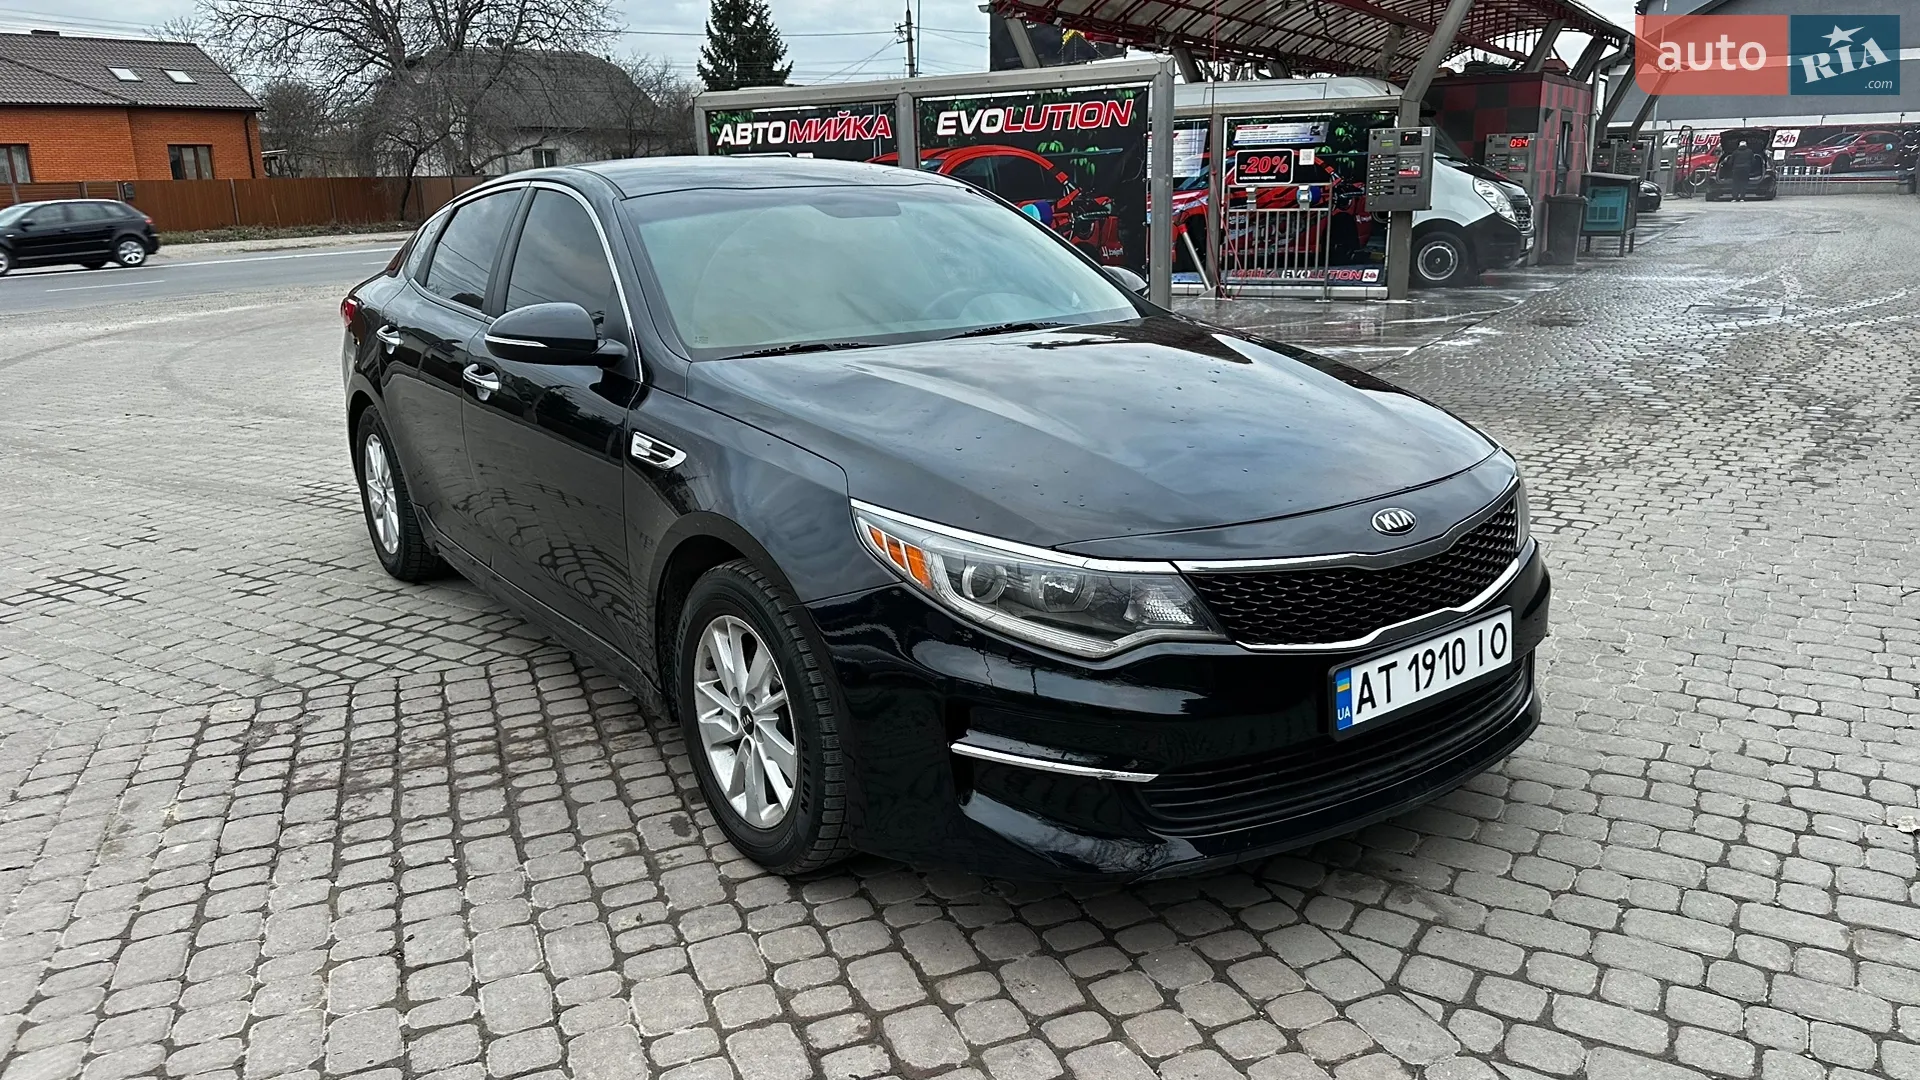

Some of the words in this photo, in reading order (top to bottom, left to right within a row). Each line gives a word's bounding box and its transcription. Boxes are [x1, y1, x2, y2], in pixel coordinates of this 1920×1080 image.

[716, 111, 892, 146] АВТОМИЙКА
[937, 99, 1134, 136] EVOLUTION
[1239, 155, 1289, 174] -20%
[1378, 510, 1414, 530] KIA
[1356, 660, 1398, 715] AT
[1407, 637, 1466, 692] 1910
[1337, 705, 1351, 721] UA
